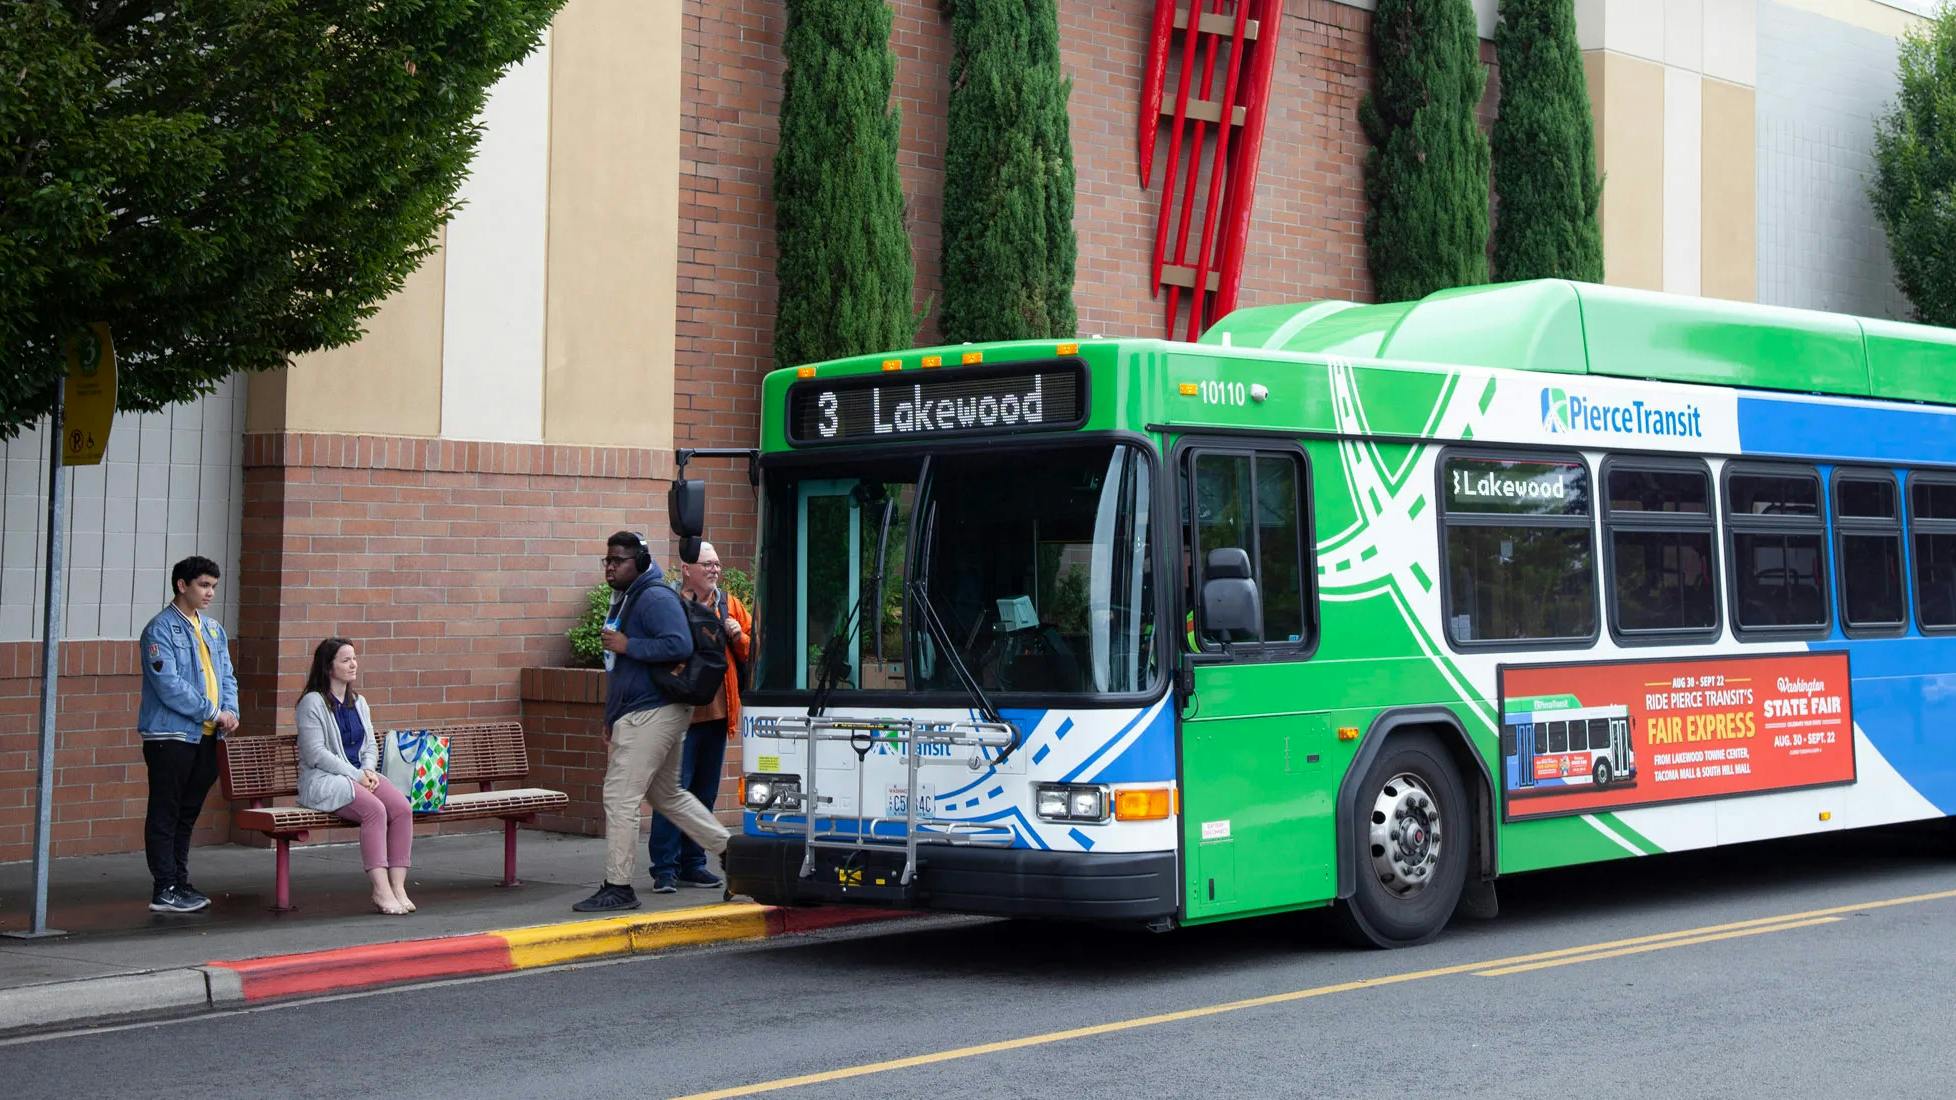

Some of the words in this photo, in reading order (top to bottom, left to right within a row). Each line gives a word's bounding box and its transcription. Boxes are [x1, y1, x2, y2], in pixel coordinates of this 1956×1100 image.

[1200, 380, 1245, 406] 10110
[818, 391, 838, 437] 3
[873, 374, 1043, 434] Lakewood
[1569, 396, 1702, 437] PierceTransit
[1463, 471, 1564, 498] Lakewood
[1672, 677, 1686, 688] AUG
[1687, 677, 1695, 688] 30
[1700, 676, 1715, 687] SEPT
[1716, 675, 1725, 687] 22
[1777, 676, 1825, 697] Washington
[1646, 694, 1668, 710] RIDE
[1671, 691, 1702, 708] PIERCE
[1705, 689, 1753, 706] TRANSIT'S
[1763, 697, 1808, 718] STATE
[1811, 696, 1841, 714] FAIR
[1648, 716, 1683, 744] FAIR
[1687, 711, 1756, 742] EXPRESS
[1774, 734, 1792, 748] AUG.
[1793, 734, 1802, 746] 30
[1808, 732, 1826, 745] SEPT.
[1827, 731, 1835, 743] 22
[1654, 753, 1671, 766] FROM
[1672, 751, 1704, 764] LAKEWOOD
[1704, 749, 1725, 761] TOWNE
[1655, 770, 1679, 782] TACOMA
[1680, 768, 1696, 780] MALL
[1696, 768, 1701, 778] &
[1702, 765, 1721, 778] SOUTH
[1722, 764, 1734, 776] HILL
[1735, 763, 1751, 775] MALL
